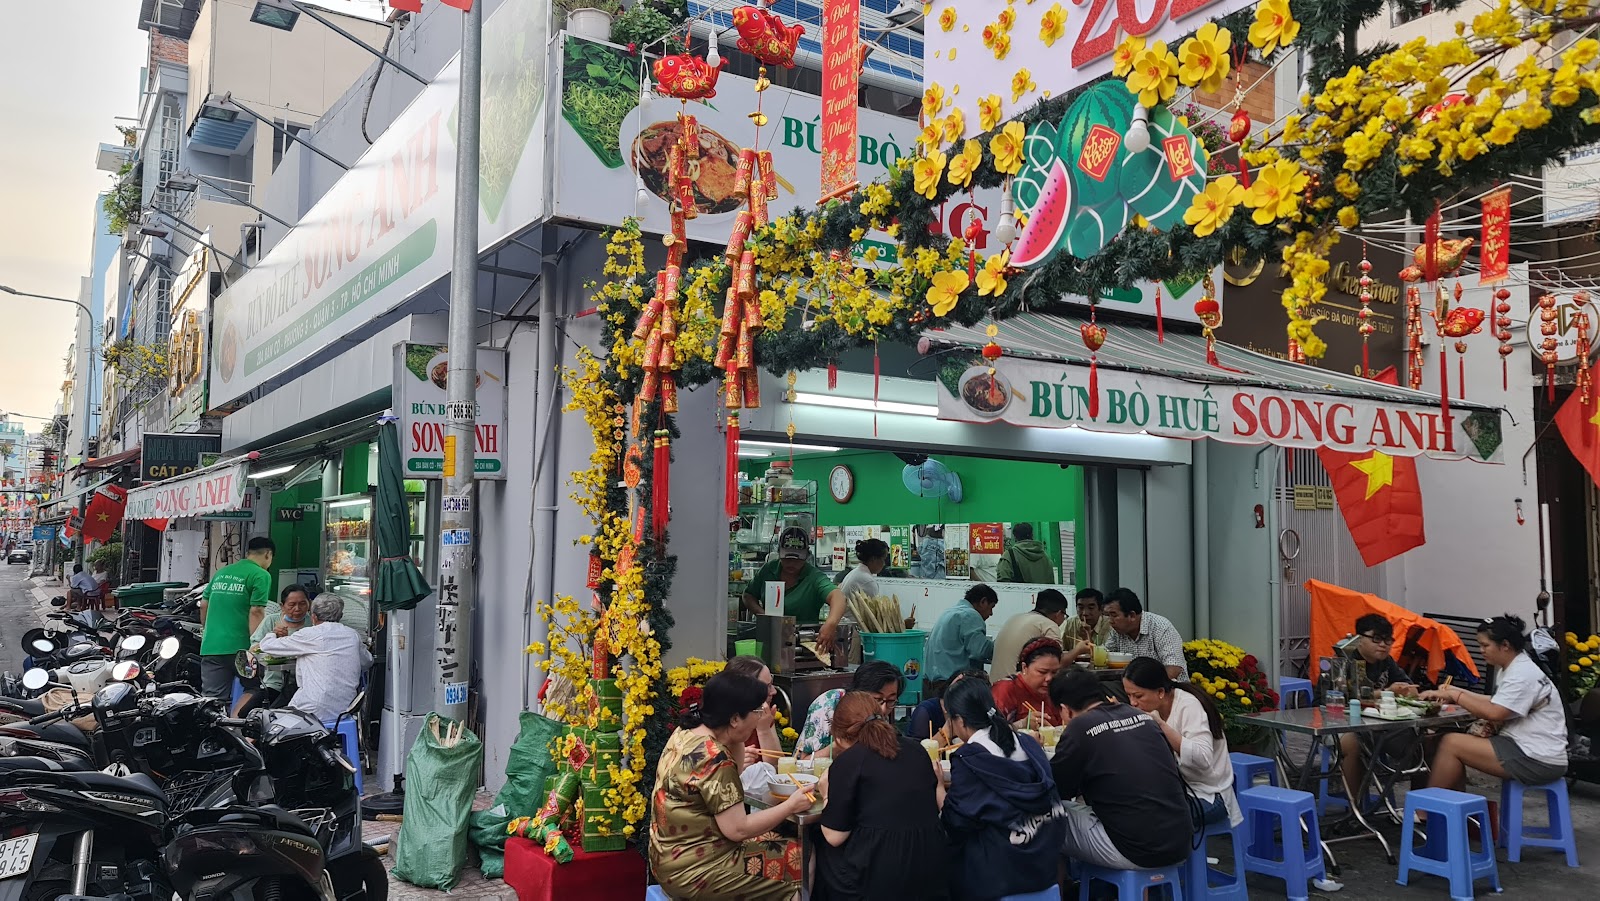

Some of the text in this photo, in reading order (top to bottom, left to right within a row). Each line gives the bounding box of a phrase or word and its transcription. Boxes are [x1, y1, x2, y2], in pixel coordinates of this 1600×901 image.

[782, 114, 821, 153] BÚ
[303, 193, 365, 298] SONG
[367, 111, 442, 247] ANH
[340, 292, 350, 312] TP.
[351, 274, 363, 303] HỒ
[364, 263, 378, 298] CHÍ
[378, 254, 400, 289] MINH
[1331, 310, 1341, 323] ĐÁ
[412, 401, 446, 416] BÚN B
[1029, 372, 1457, 453] BÚN BÒ HUẾ SONG ANH
[412, 422, 498, 453] SON NH
[149, 462, 178, 478] CÁT
[155, 485, 190, 513] SONG
[194, 474, 233, 510] ANH
[281, 509, 302, 519] WC
[227, 583, 245, 592] ANH
[924, 588, 929, 597] 2
[1031, 594, 1035, 604] 1
[1120, 717, 1134, 727] WITH
[202, 871, 226, 880] HONDA
